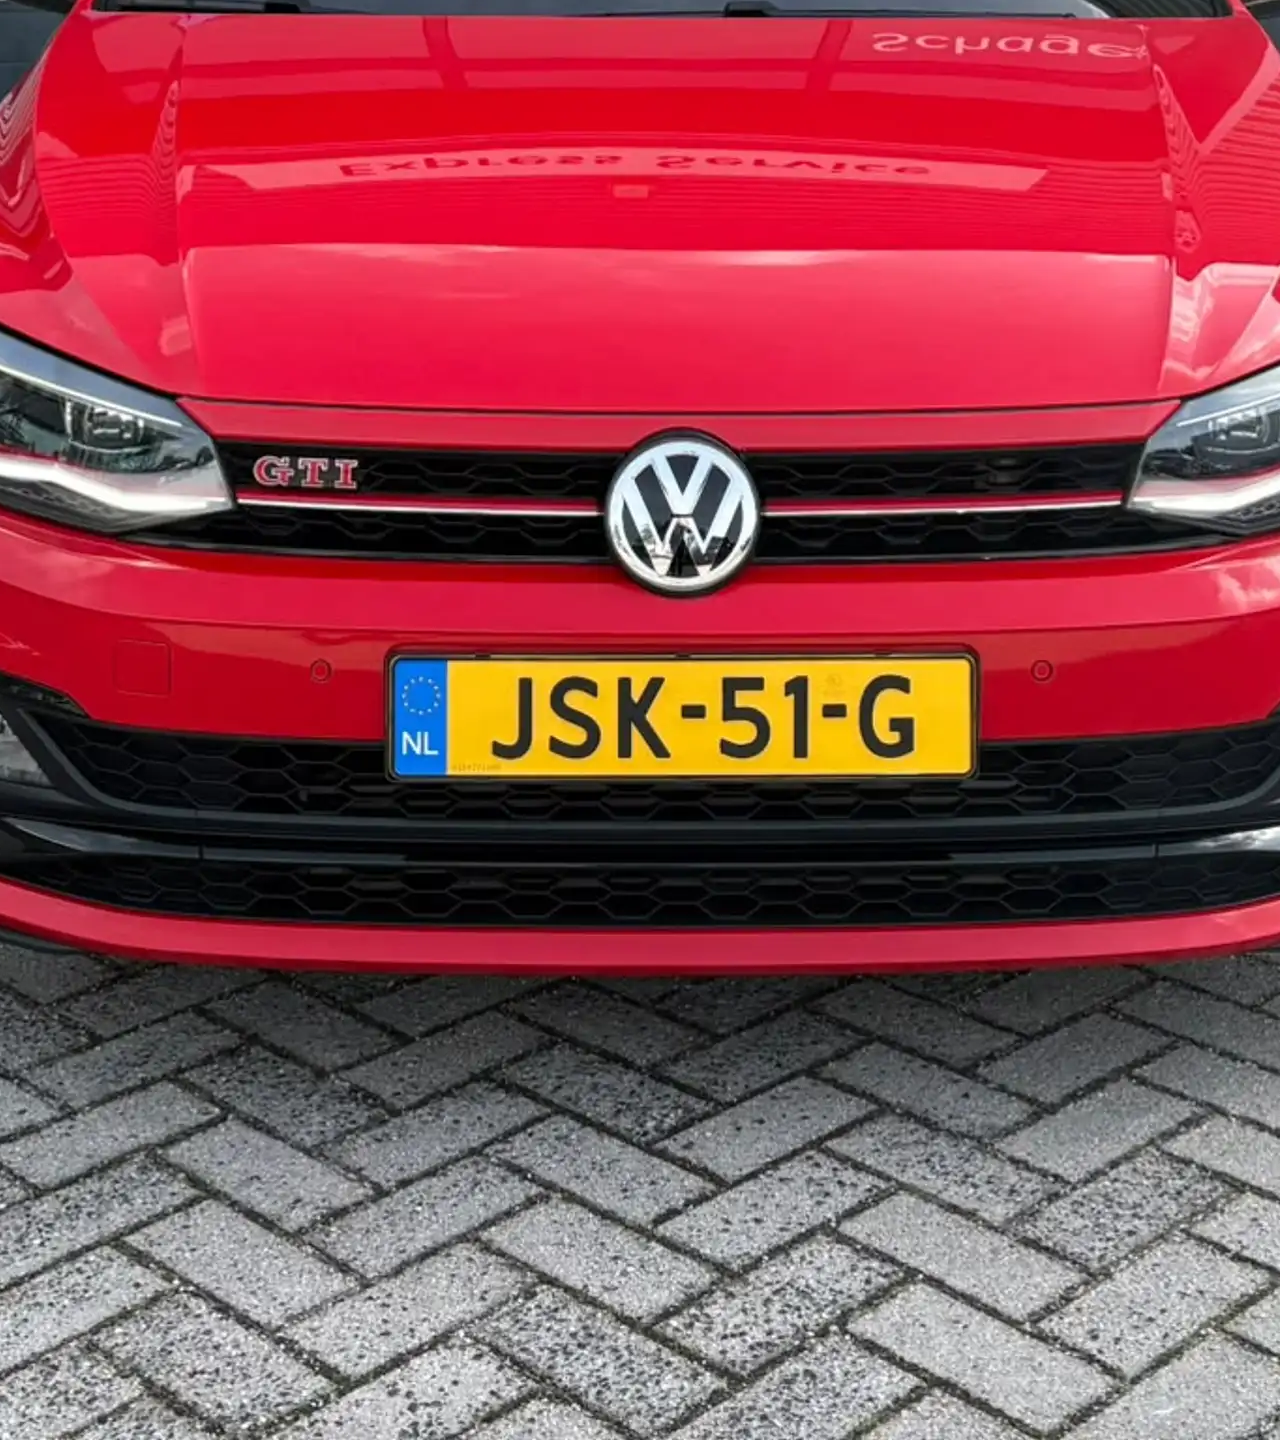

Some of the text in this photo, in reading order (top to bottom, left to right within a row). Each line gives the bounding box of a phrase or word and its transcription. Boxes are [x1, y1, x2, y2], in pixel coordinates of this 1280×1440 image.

[253, 455, 358, 489] GTI
[491, 674, 915, 759] JSK-51-G
[402, 731, 439, 756] NL
